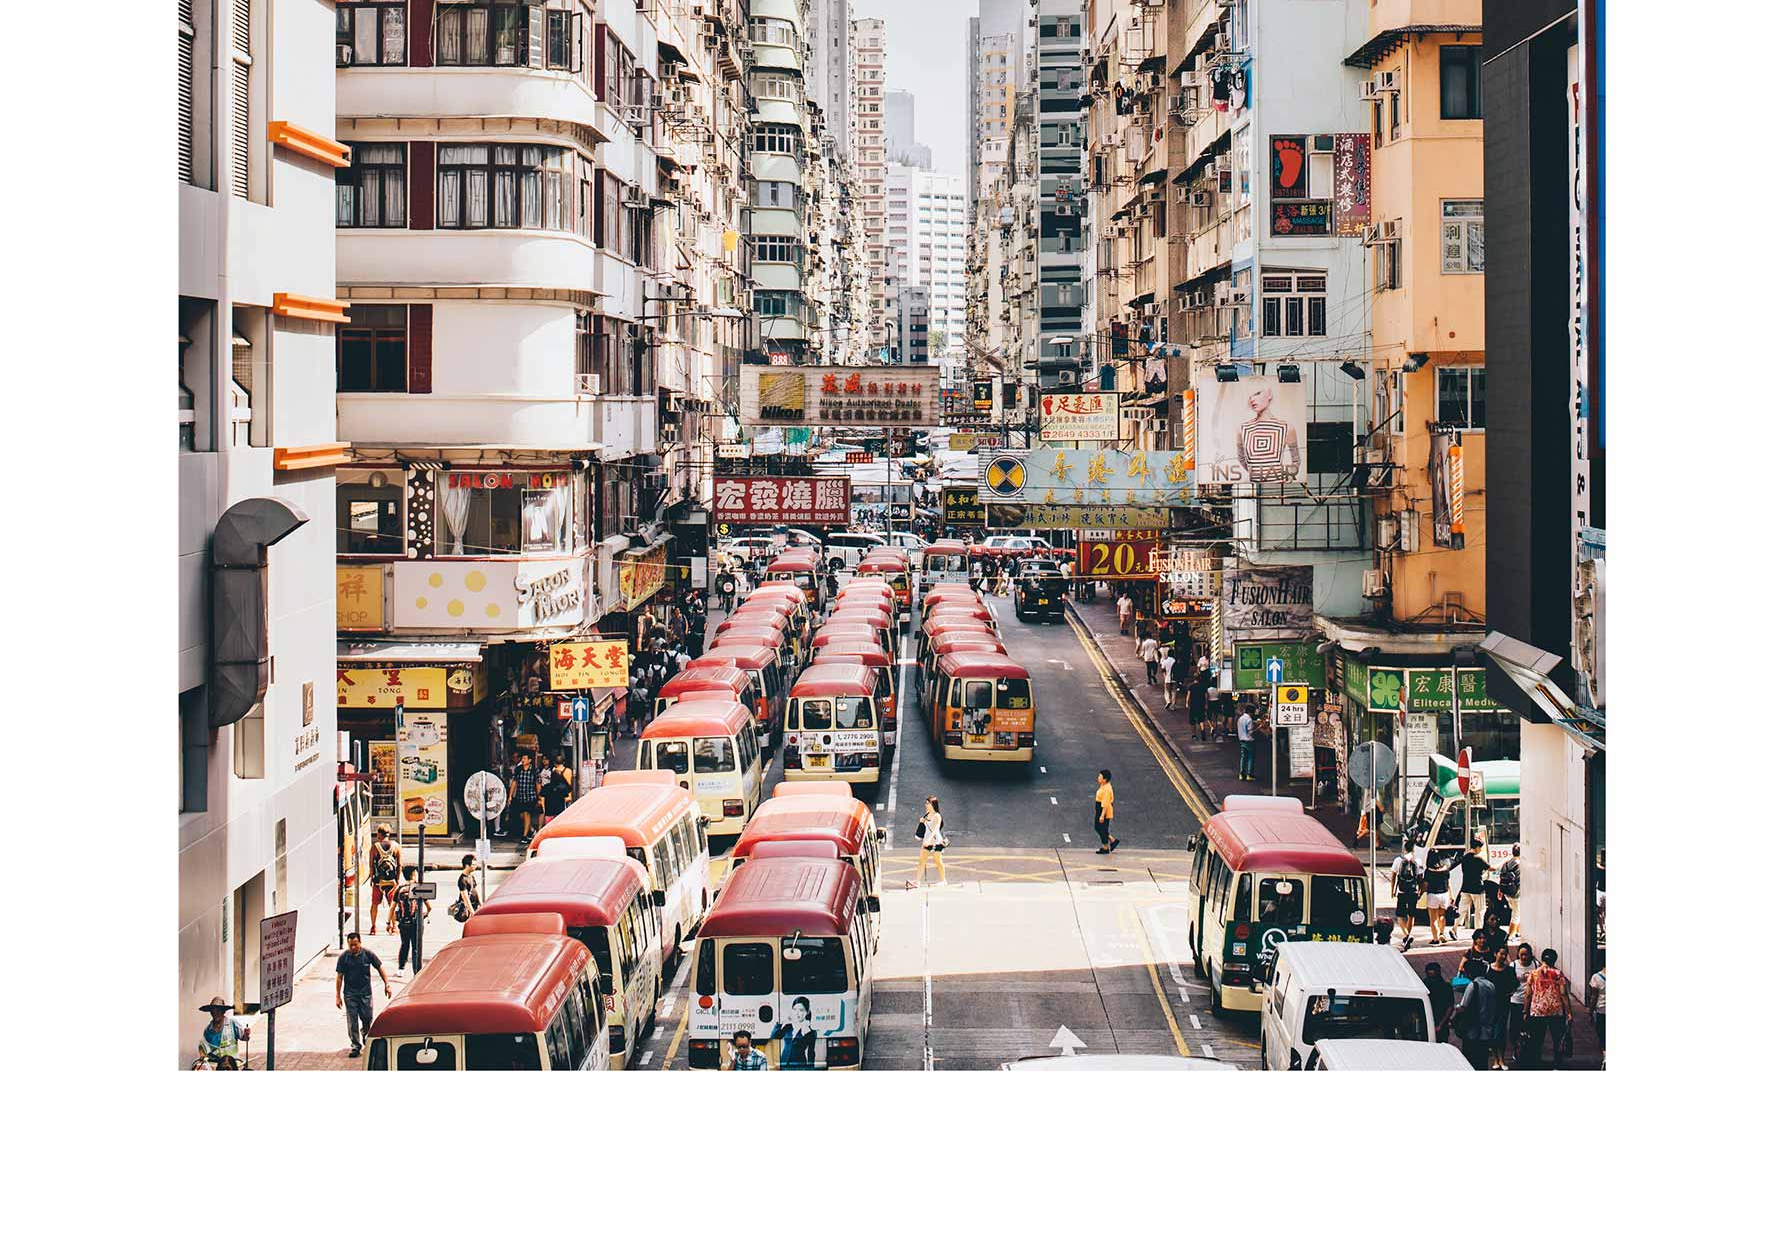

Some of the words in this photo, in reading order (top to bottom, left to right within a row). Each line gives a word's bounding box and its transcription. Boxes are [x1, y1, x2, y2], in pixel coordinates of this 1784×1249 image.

[819, 398, 843, 408] Nikon
[846, 398, 892, 409] Authorized
[894, 398, 922, 408] Dealer
[760, 405, 805, 420] Nikon
[1052, 430, 1076, 439] 2649
[1077, 430, 1101, 439] 4333
[448, 474, 513, 489] SALON
[716, 480, 846, 511] 宏發燒臘
[1091, 543, 1135, 575] 20
[1159, 571, 1200, 584] SALON
[1250, 610, 1288, 627] SALON
[554, 645, 626, 671] 海天堂
[1292, 704, 1304, 712] hrs
[1283, 713, 1302, 722] 全日
[720, 1022, 737, 1031] 2111
[737, 1022, 756, 1031] 0998
